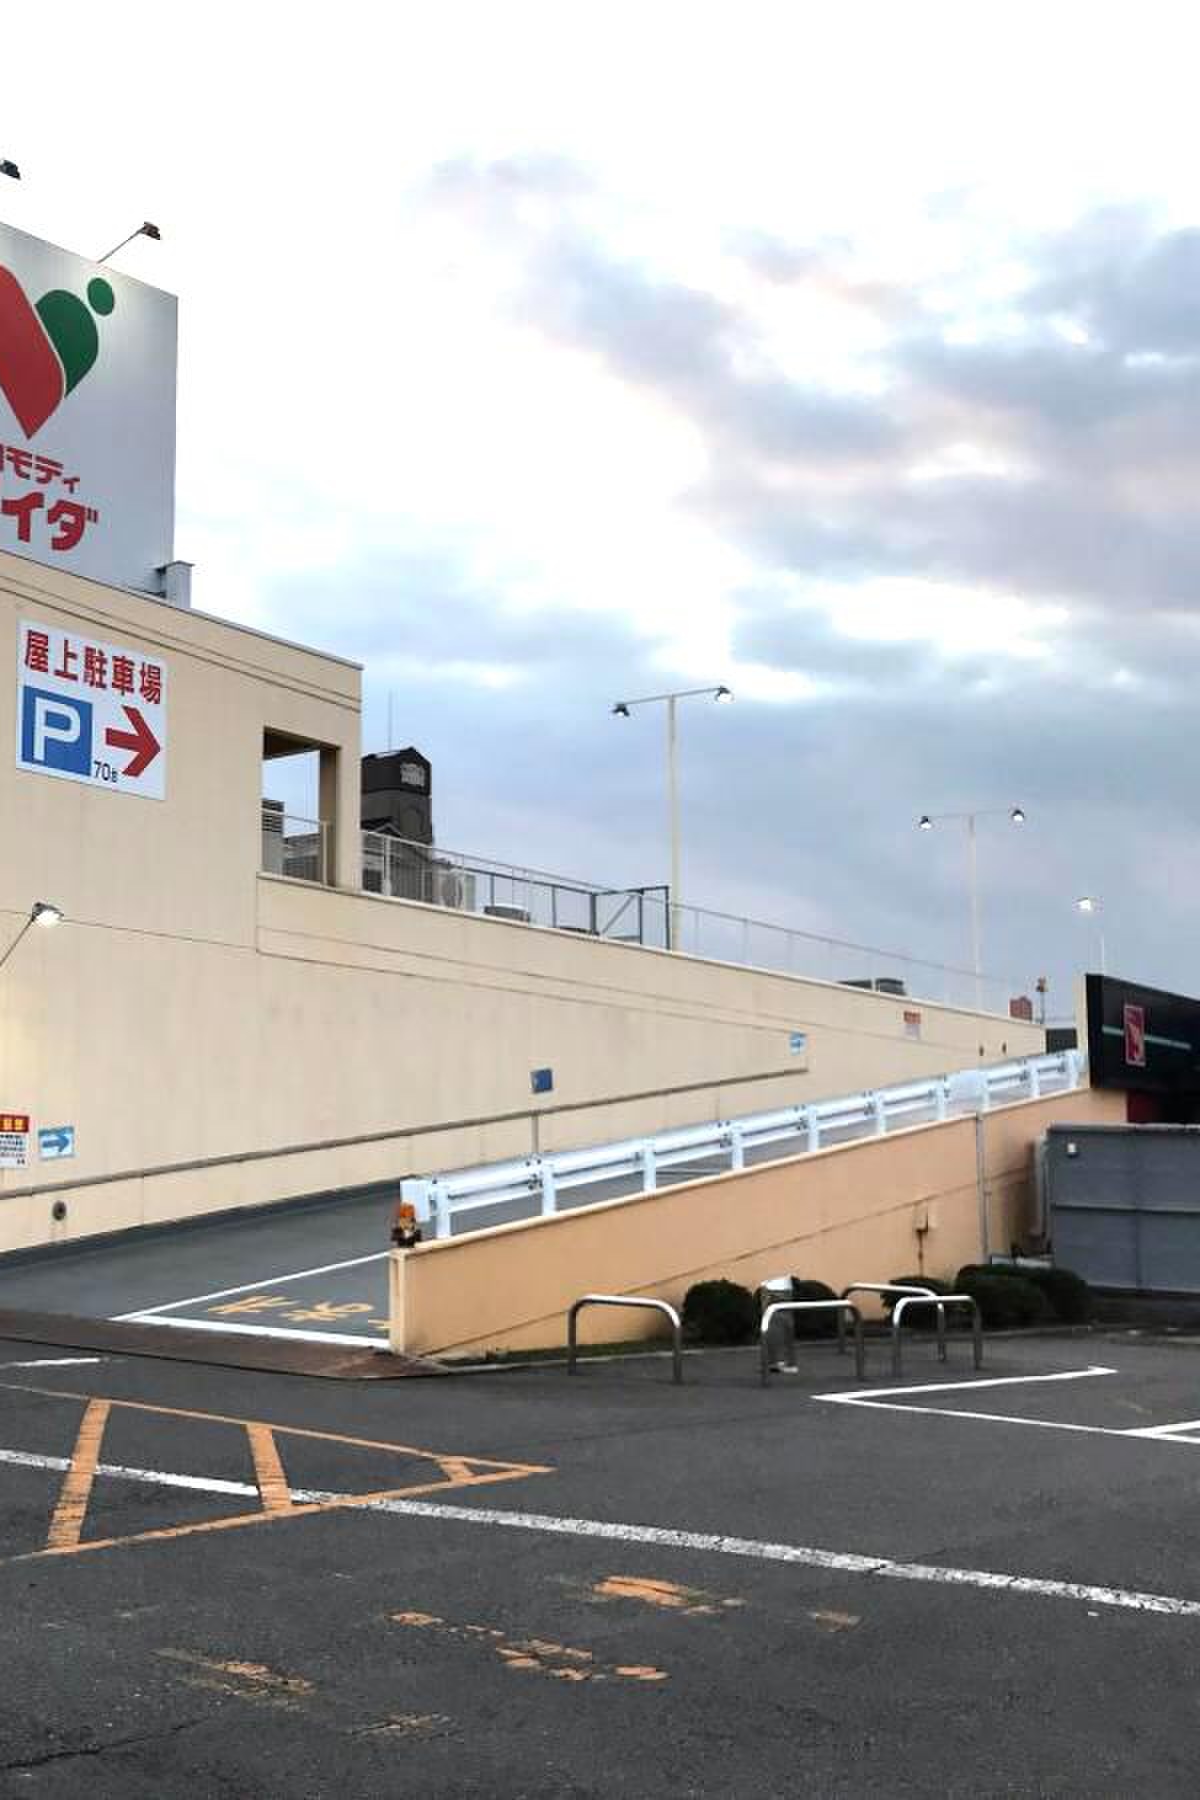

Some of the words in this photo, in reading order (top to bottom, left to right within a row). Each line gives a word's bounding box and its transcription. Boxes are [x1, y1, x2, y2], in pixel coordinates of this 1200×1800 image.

[25, 629, 162, 704] 屋上駐車場
[32, 695, 81, 762] P
